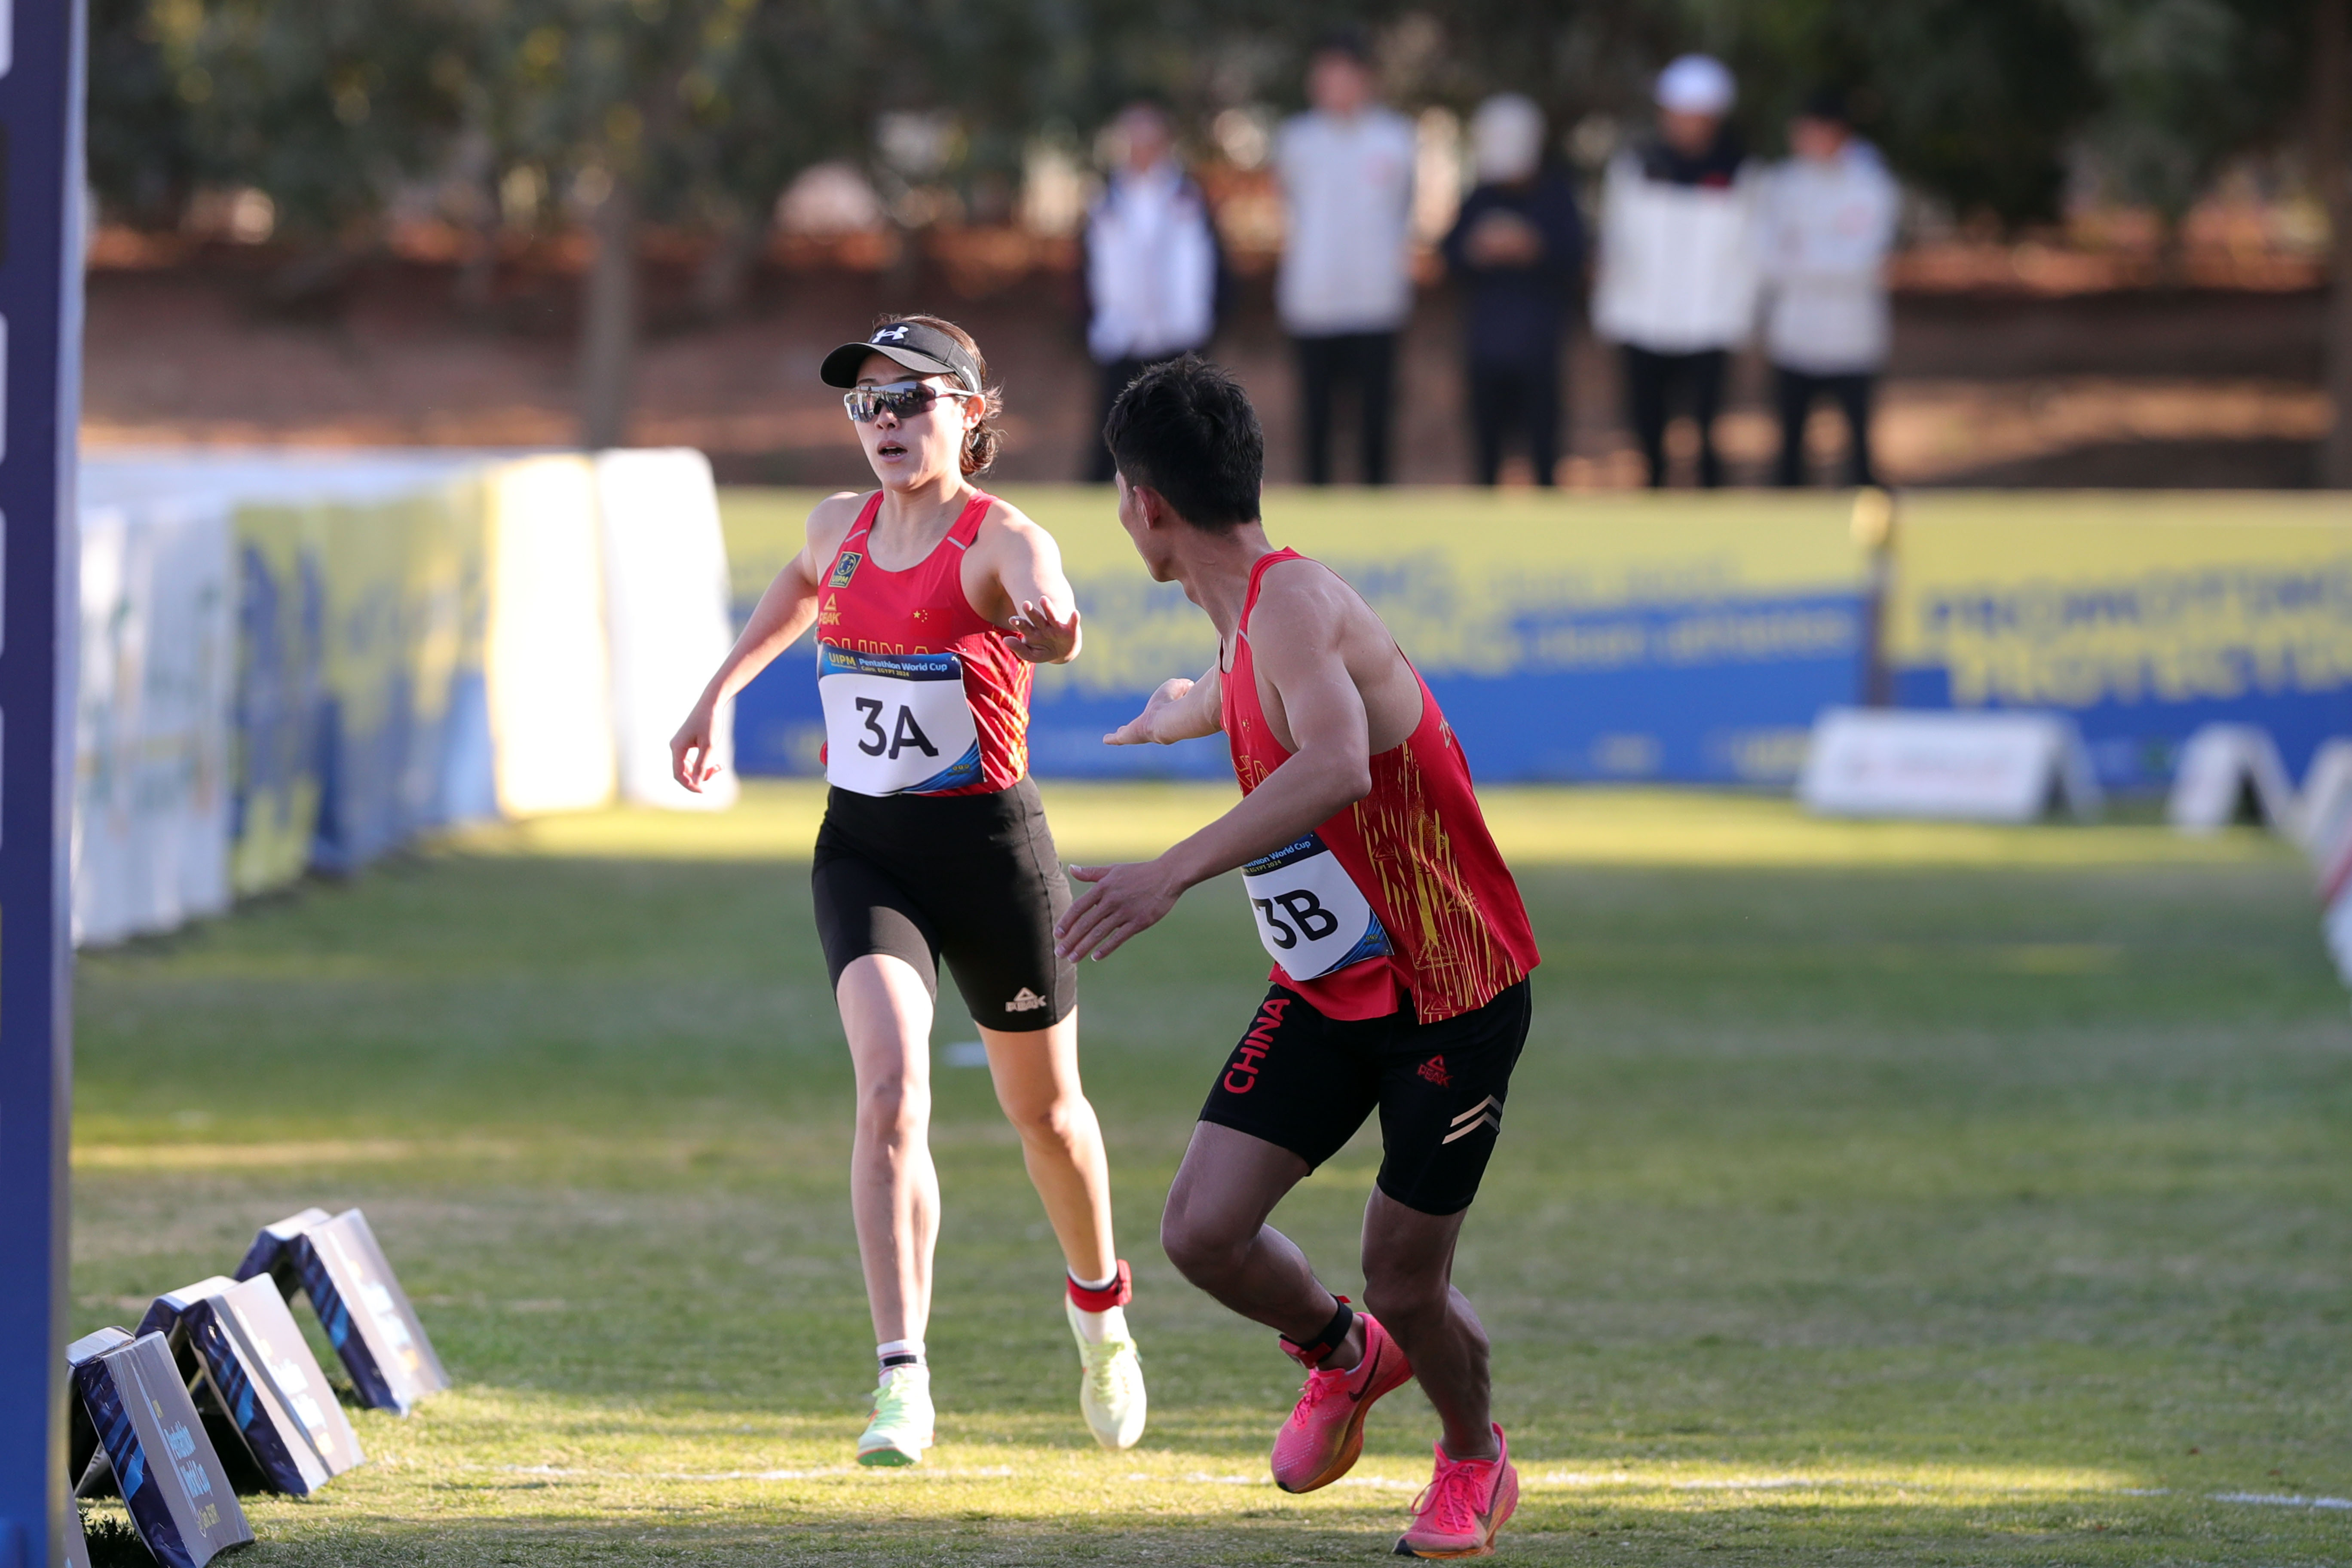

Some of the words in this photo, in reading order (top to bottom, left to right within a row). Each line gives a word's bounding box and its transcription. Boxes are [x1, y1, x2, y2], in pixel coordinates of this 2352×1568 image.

[819, 612, 842, 626] PEAK
[829, 652, 856, 666] UIPM
[858, 658, 901, 670] Pentathlon
[901, 662, 928, 671] World
[929, 662, 948, 672] Cup
[855, 696, 938, 760] 3A
[1269, 845, 1295, 860] World
[1294, 840, 1311, 851] Cup
[1266, 860, 1282, 868] 2024
[1251, 889, 1338, 949] 3B
[1224, 998, 1290, 1094] CHINA
[1417, 1064, 1454, 1088] PEAK
